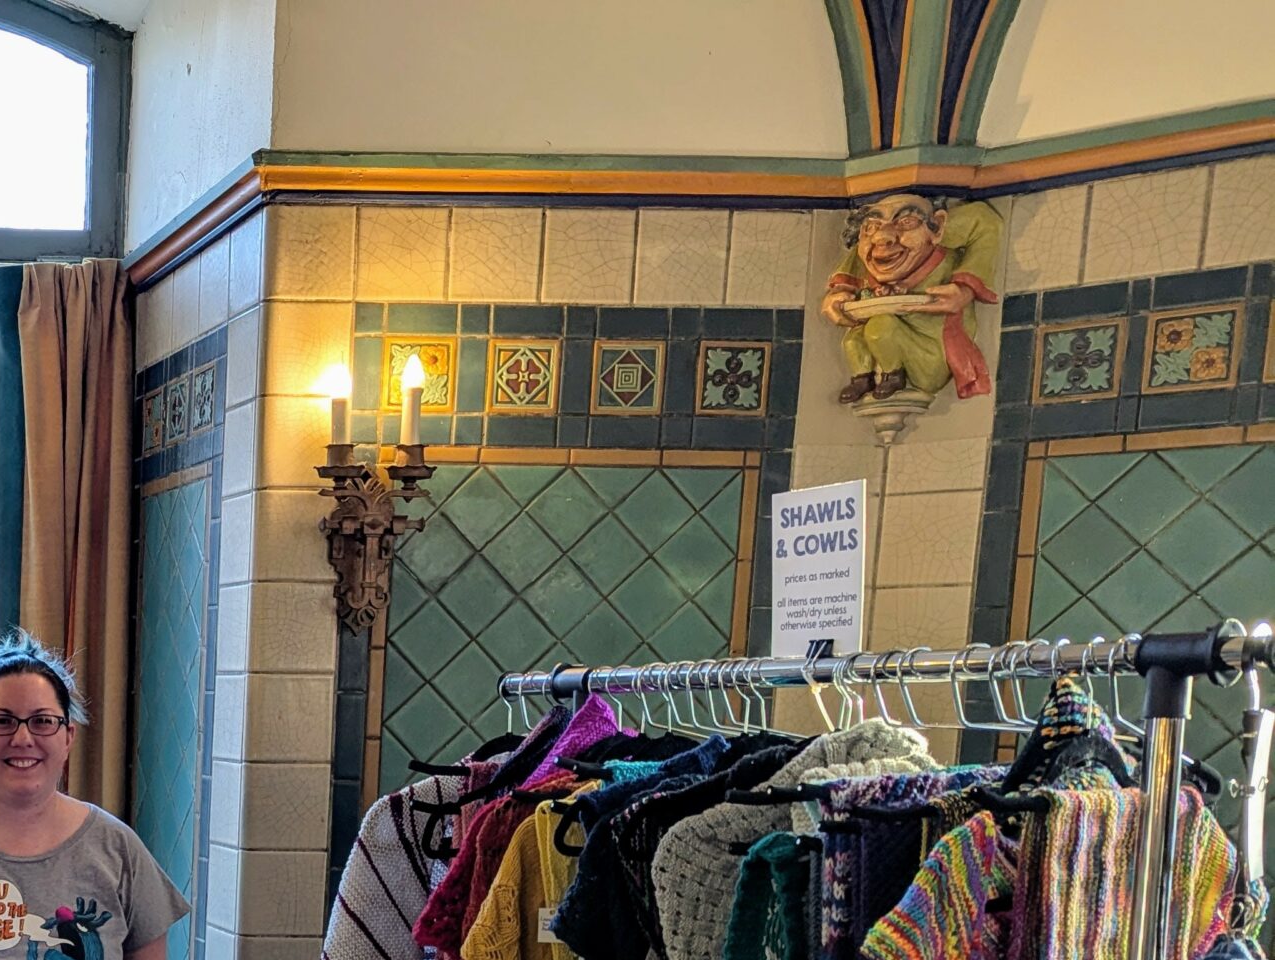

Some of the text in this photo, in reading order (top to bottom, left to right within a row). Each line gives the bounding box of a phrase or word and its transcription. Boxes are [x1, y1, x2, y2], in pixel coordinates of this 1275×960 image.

[780, 497, 855, 529] SHAWLS
[776, 528, 858, 558] & COWLS
[785, 567, 850, 586] prices as marked
[777, 592, 857, 608] all items are machine
[787, 606, 847, 619] wash/dry unless
[780, 616, 852, 631] otherwise specified
[8, 902, 28, 918] THE
